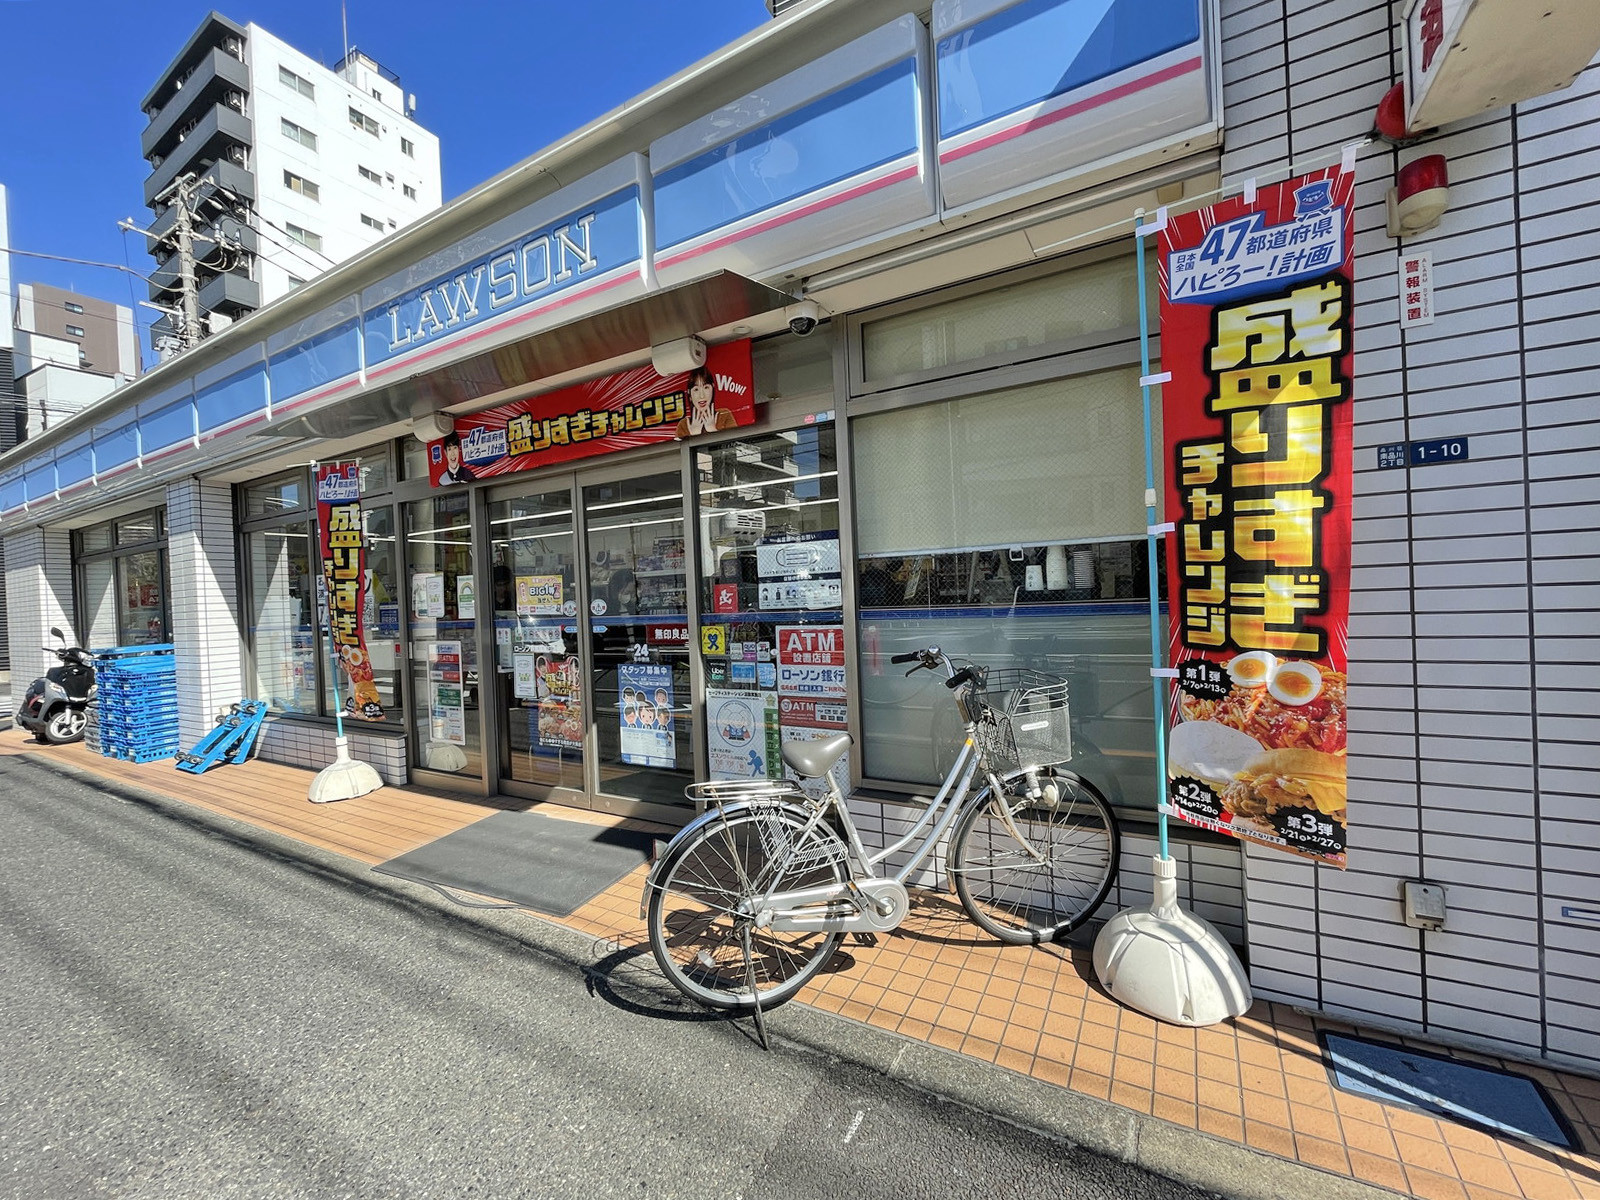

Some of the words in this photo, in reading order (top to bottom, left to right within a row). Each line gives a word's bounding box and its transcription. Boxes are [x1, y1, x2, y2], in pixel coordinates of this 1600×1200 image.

[1200, 217, 1333, 266] 47都道府県
[1175, 261, 1195, 273] 全国
[1175, 240, 1336, 295] ハピろー!計画
[1176, 253, 1196, 264] 日本
[388, 213, 598, 352] LAWSON
[1405, 260, 1422, 320] 警報装置
[507, 391, 687, 457] 盛りすぎチャレンジ
[1380, 451, 1404, 460] 南品川
[1418, 443, 1461, 459] 1-10
[1211, 280, 1342, 653] 盛りすぎ
[1380, 458, 1404, 467] 2丁目
[1182, 443, 1226, 647] チャレンジ
[329, 503, 362, 645] 盛りすぎ
[654, 628, 690, 640] 無印良品
[786, 632, 835, 652] ATM
[633, 643, 650, 657] 24
[792, 652, 832, 664] 設置店舗
[620, 665, 668, 676] スタッフ募集中
[781, 669, 845, 683] ローソン銀行
[1186, 664, 1221, 682] 第1弾
[792, 701, 814, 711] ATM
[1178, 783, 1212, 804] 第2弾
[1287, 813, 1334, 837] 第3弾
